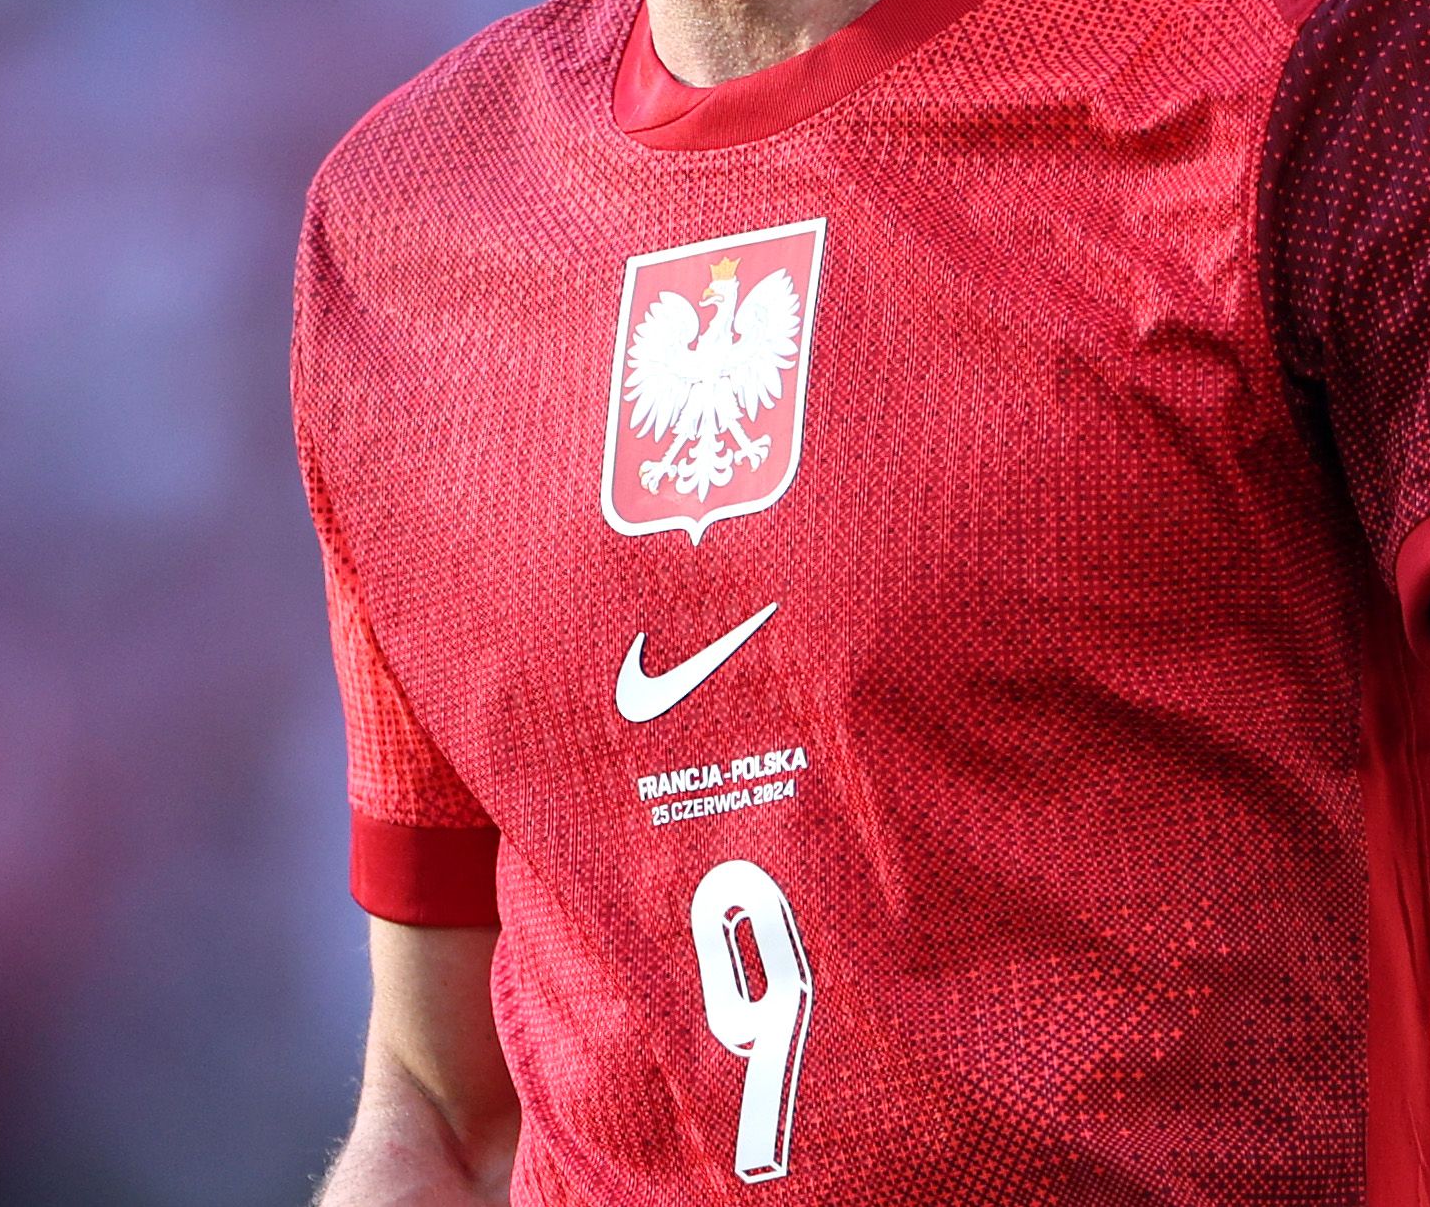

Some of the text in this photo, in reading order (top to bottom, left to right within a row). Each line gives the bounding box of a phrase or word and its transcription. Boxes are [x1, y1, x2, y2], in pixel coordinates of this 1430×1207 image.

[651, 778, 795, 826] 25 CZERWCA 2024
[690, 859, 813, 1184] 9
